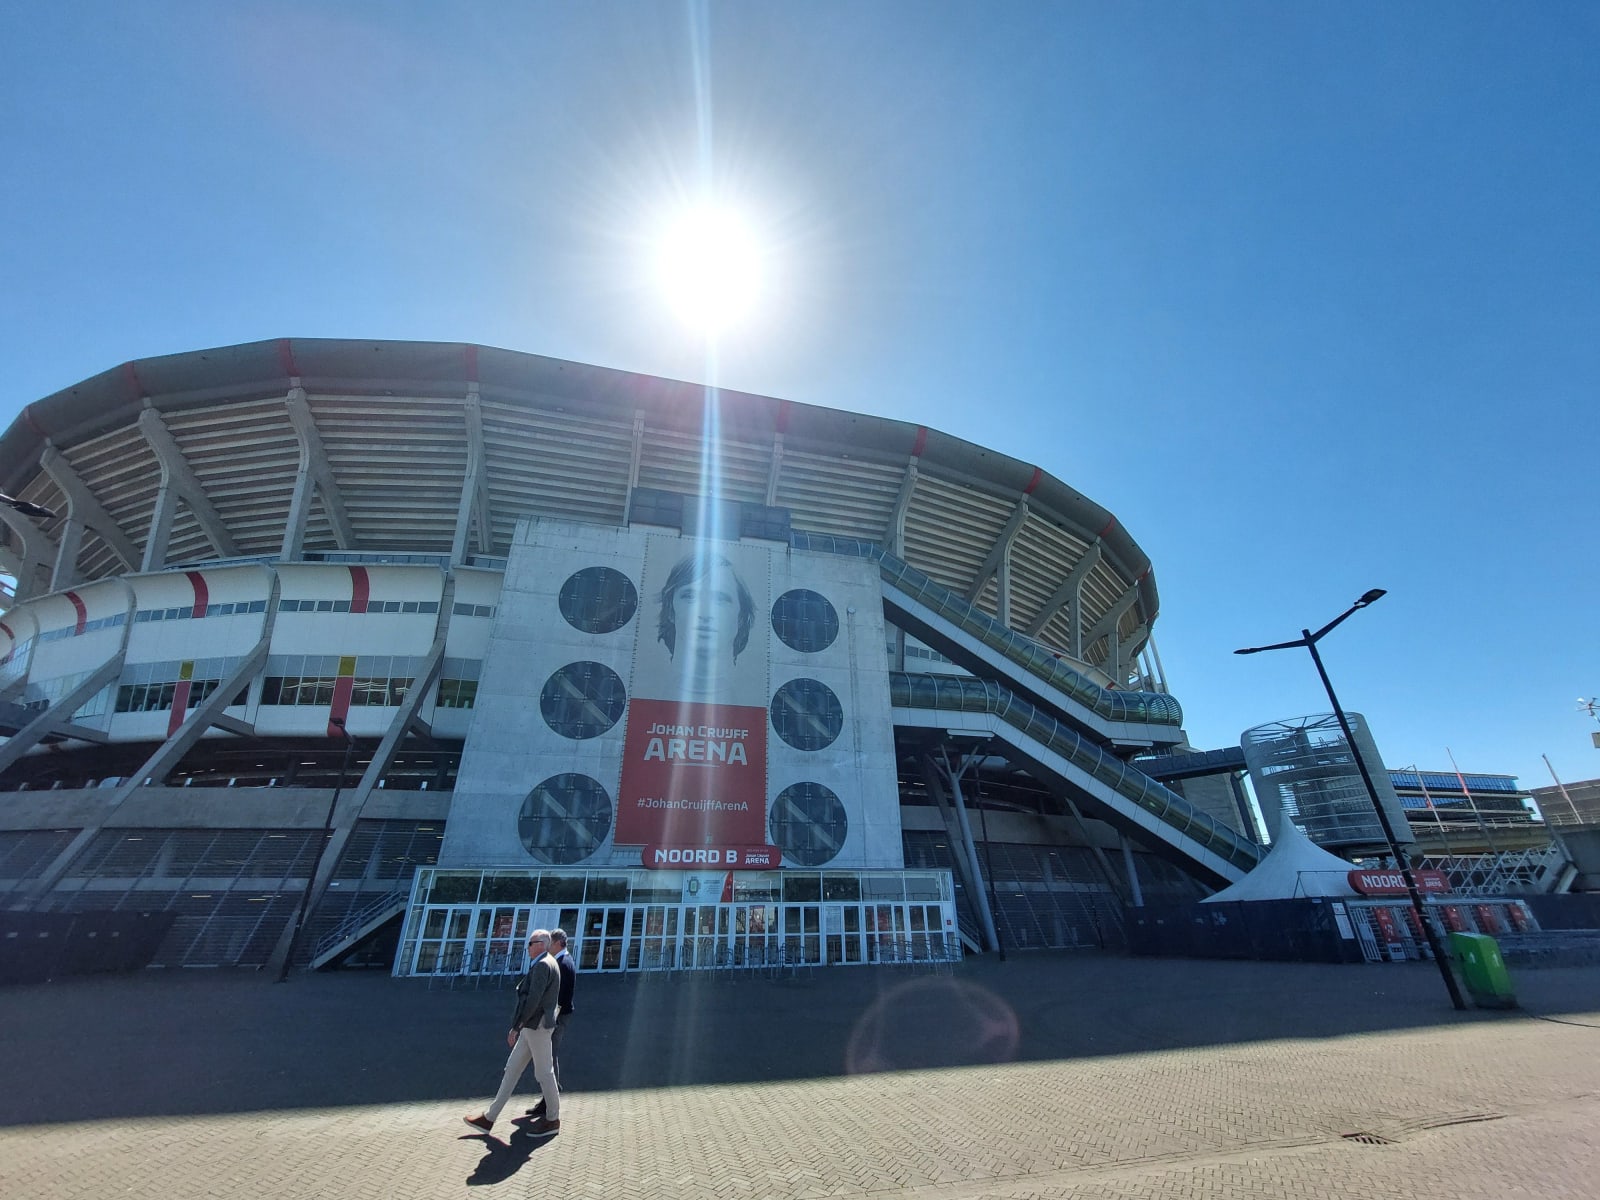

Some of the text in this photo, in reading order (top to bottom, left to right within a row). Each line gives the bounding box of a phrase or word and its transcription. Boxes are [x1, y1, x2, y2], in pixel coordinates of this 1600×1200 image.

[646, 722, 749, 740] JOHAN CRUIJFF
[643, 737, 748, 766] ARENA
[637, 797, 749, 812] #JohanCruijffArenA
[654, 849, 738, 863] NOORD B
[745, 857, 770, 865] ARENA
